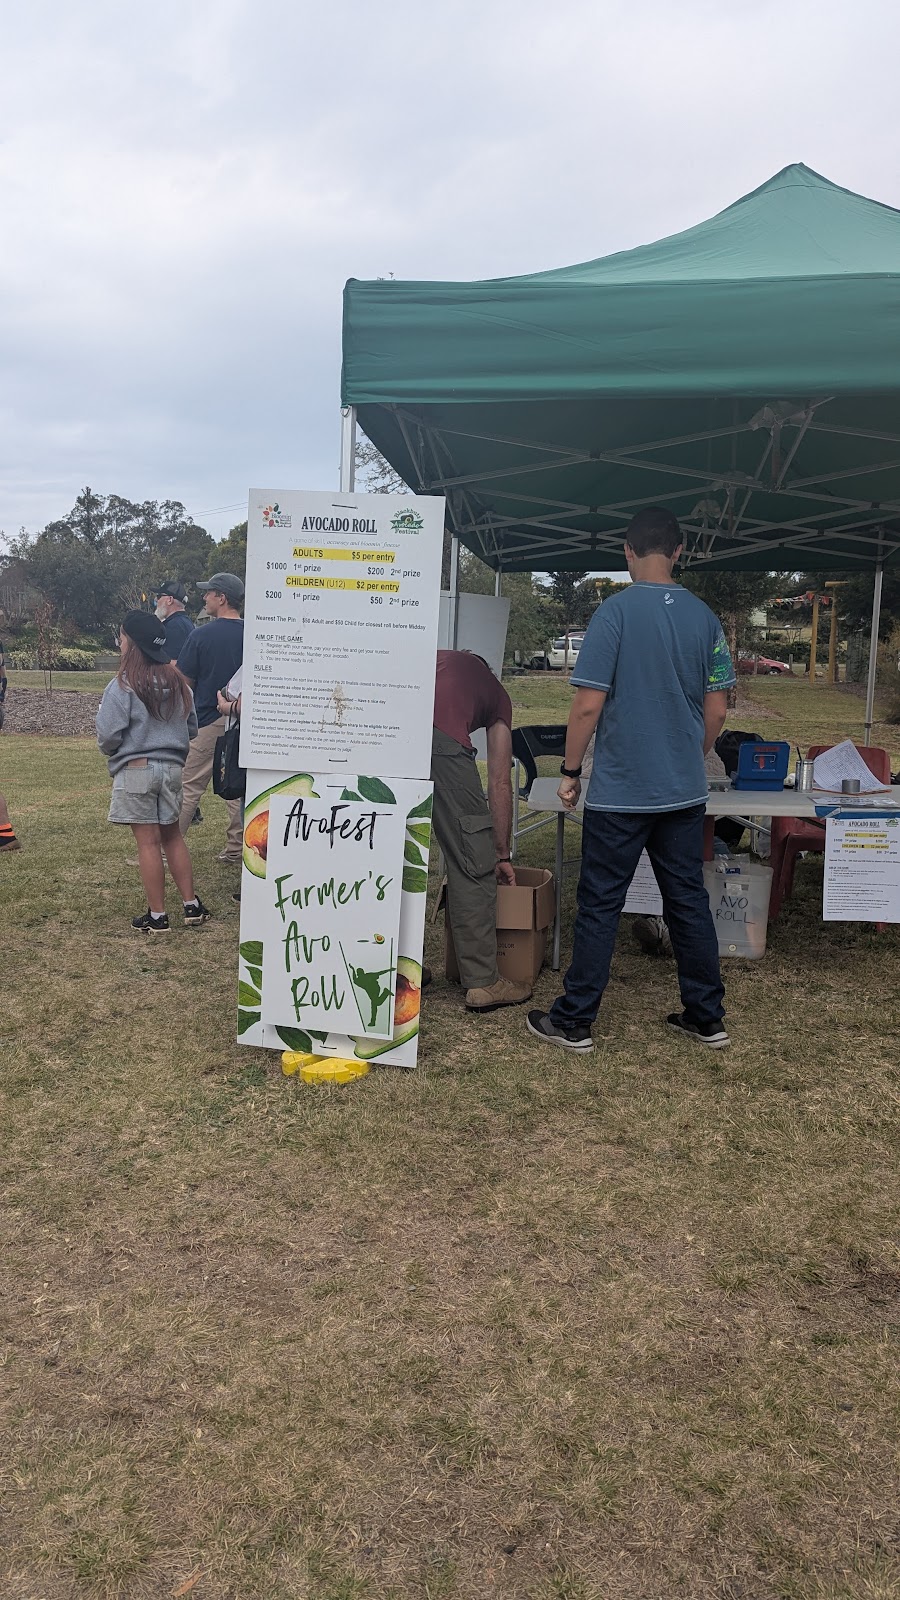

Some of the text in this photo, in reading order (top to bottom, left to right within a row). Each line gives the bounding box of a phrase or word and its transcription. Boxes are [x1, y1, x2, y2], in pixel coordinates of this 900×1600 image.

[301, 516, 377, 533] AVOCADO ROLL
[293, 549, 323, 557] ADULTS
[266, 562, 287, 570] $1000
[304, 564, 321, 572] prize
[368, 567, 384, 575] $200
[403, 569, 420, 578] prize
[286, 578, 324, 586] CHILDREN
[327, 580, 345, 590] (U12)
[380, 583, 399, 592] entry
[303, 593, 320, 601] prize
[401, 599, 419, 607] prize
[284, 798, 393, 850] AvoFest
[274, 870, 394, 922] Farmer's
[720, 896, 748, 909] AVO
[716, 909, 755, 924] ROLL
[282, 920, 330, 972] Avo
[291, 974, 345, 1022] Roll
